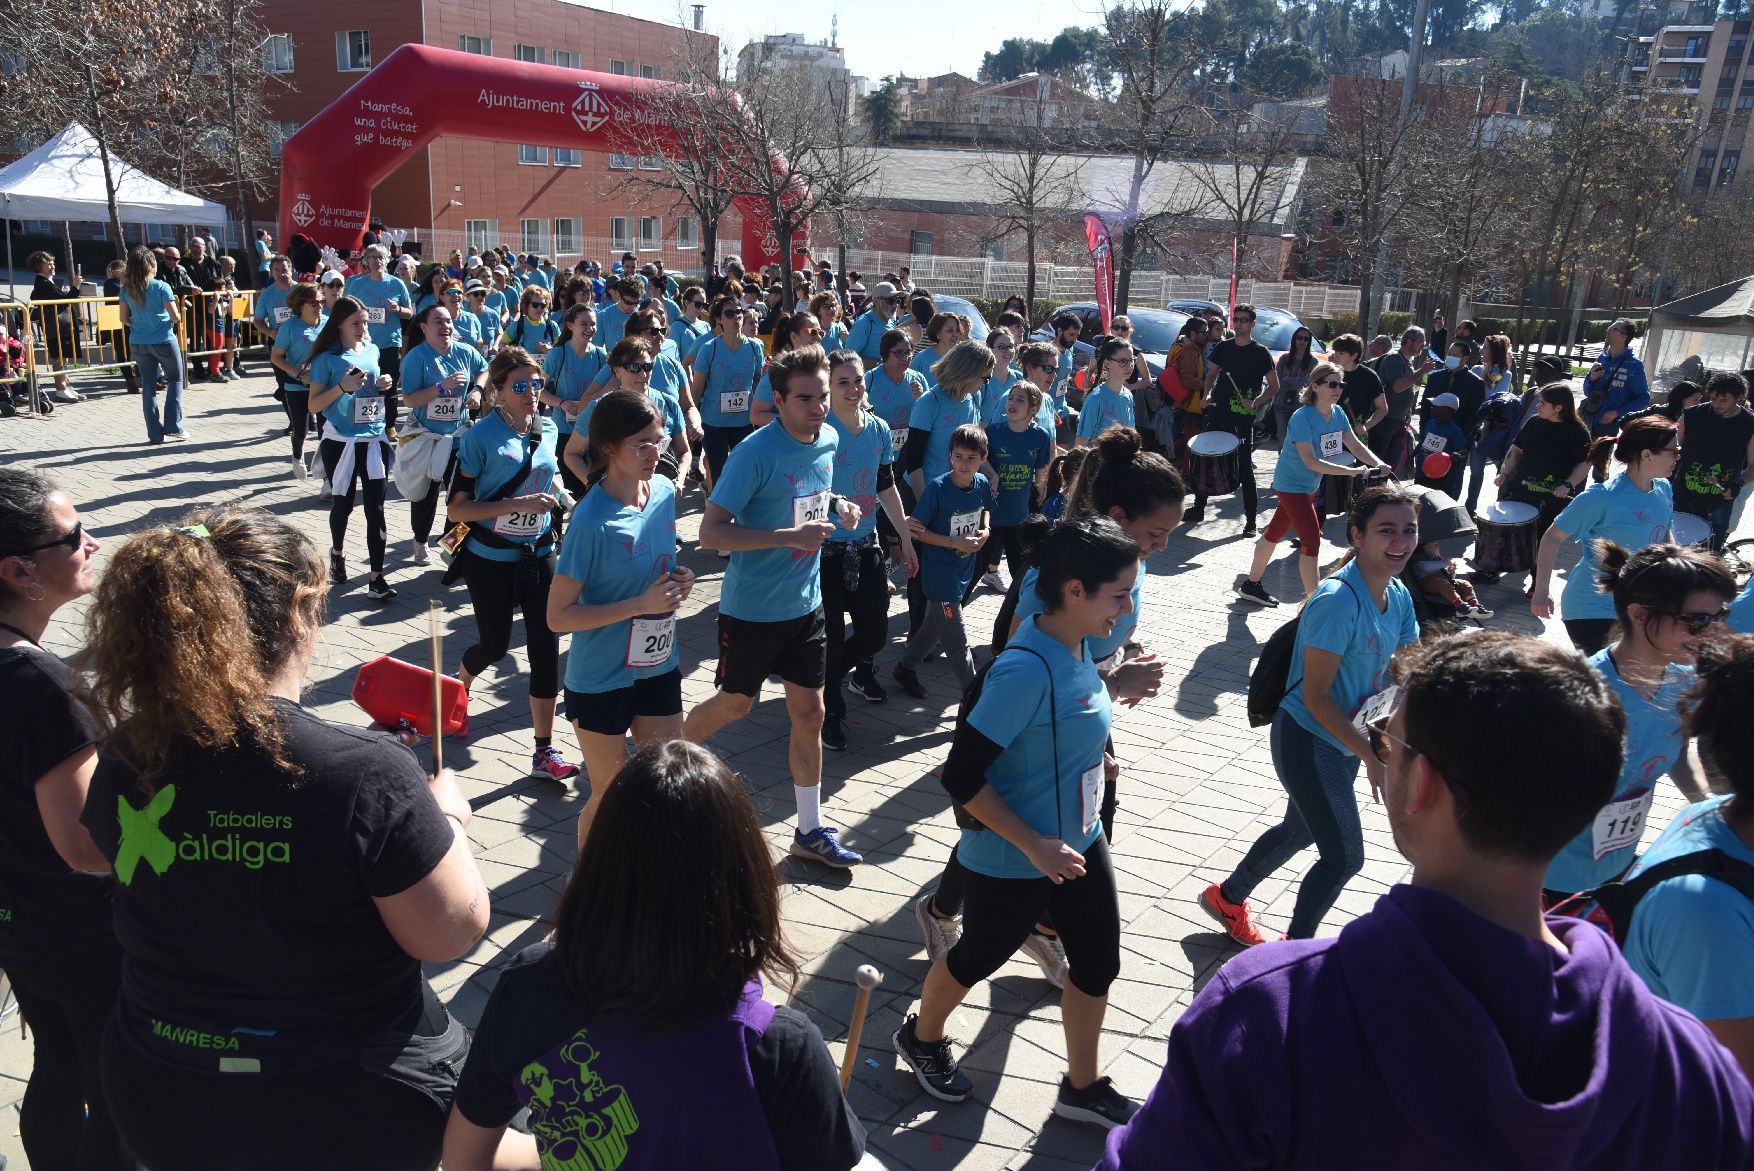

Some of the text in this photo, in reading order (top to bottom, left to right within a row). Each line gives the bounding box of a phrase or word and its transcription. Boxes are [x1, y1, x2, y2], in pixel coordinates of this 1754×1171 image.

[361, 100, 413, 116] Manresa,
[478, 89, 565, 114] Ajuntament
[354, 117, 418, 132] una ciutat
[354, 133, 413, 150] que batega
[319, 217, 332, 227] de
[368, 312, 381, 320] 283
[434, 405, 456, 415] 204
[727, 398, 744, 407] 142
[1324, 440, 1338, 450] 438
[508, 512, 538, 527] 218
[804, 506, 825, 521] 201
[643, 630, 673, 654] 200
[207, 810, 293, 829] Tabalers
[1607, 811, 1642, 838] 119
[151, 1019, 239, 1050] MANRESA
